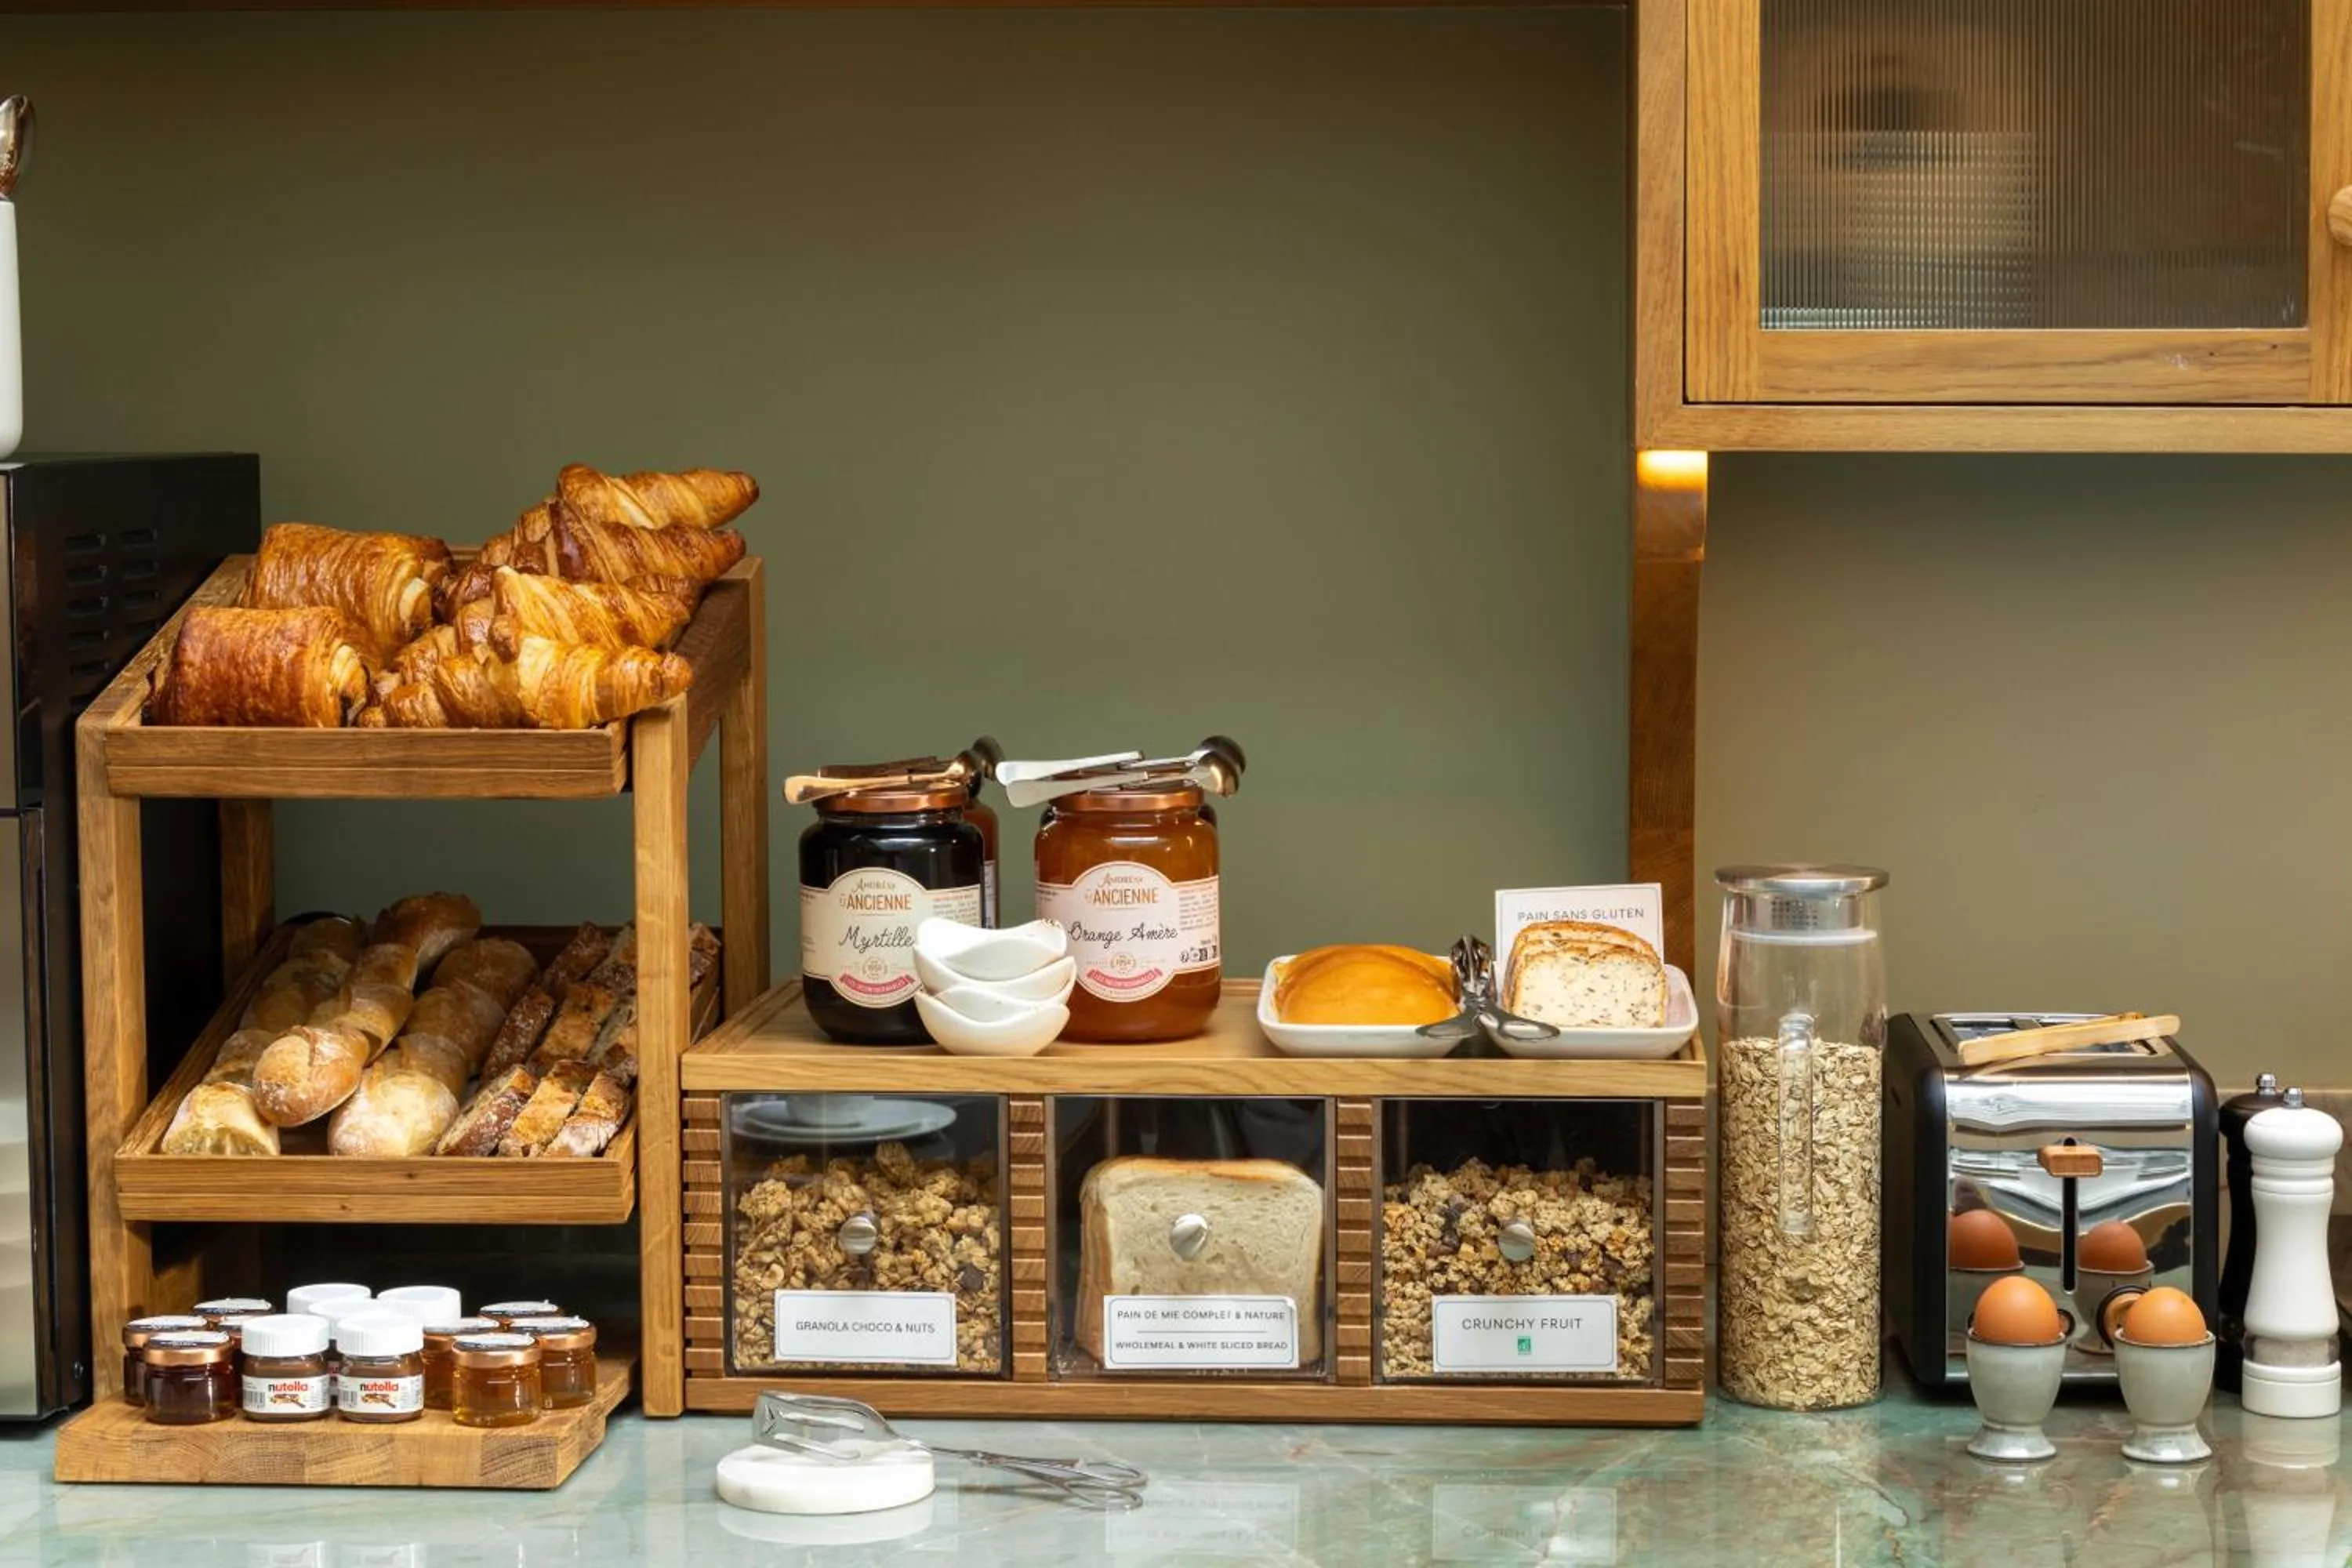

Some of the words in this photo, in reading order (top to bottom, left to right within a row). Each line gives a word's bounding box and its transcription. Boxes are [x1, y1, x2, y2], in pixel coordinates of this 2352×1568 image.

[1517, 911, 1548, 921] PAIN
[1552, 909, 1588, 920] SANS
[1592, 907, 1645, 920] GLUTEN
[838, 925, 914, 954] Myrtille
[1067, 920, 1123, 949] Orange
[1127, 922, 1178, 942] Amère
[1117, 1310, 1141, 1319] PAIN
[1145, 1310, 1158, 1319] DE
[1161, 1310, 1179, 1319] MIE
[1182, 1310, 1231, 1320] COMPLET
[1245, 1311, 1286, 1320] NATURE
[796, 1321, 849, 1331] GRANOLA
[851, 1322, 892, 1332] CHOCO
[895, 1323, 902, 1333] &
[906, 1323, 936, 1334] NUTS
[1462, 1318, 1535, 1330] CRUNCHY
[1541, 1318, 1583, 1330] FRUIT
[1115, 1341, 1175, 1350] WHOLEMEAL
[1178, 1341, 1184, 1350] &
[1186, 1341, 1218, 1350] WHITE
[1220, 1341, 1254, 1350] SLICED
[1257, 1341, 1288, 1350] BREAD
[267, 1381, 309, 1392] nutella
[360, 1381, 399, 1392] nutella
